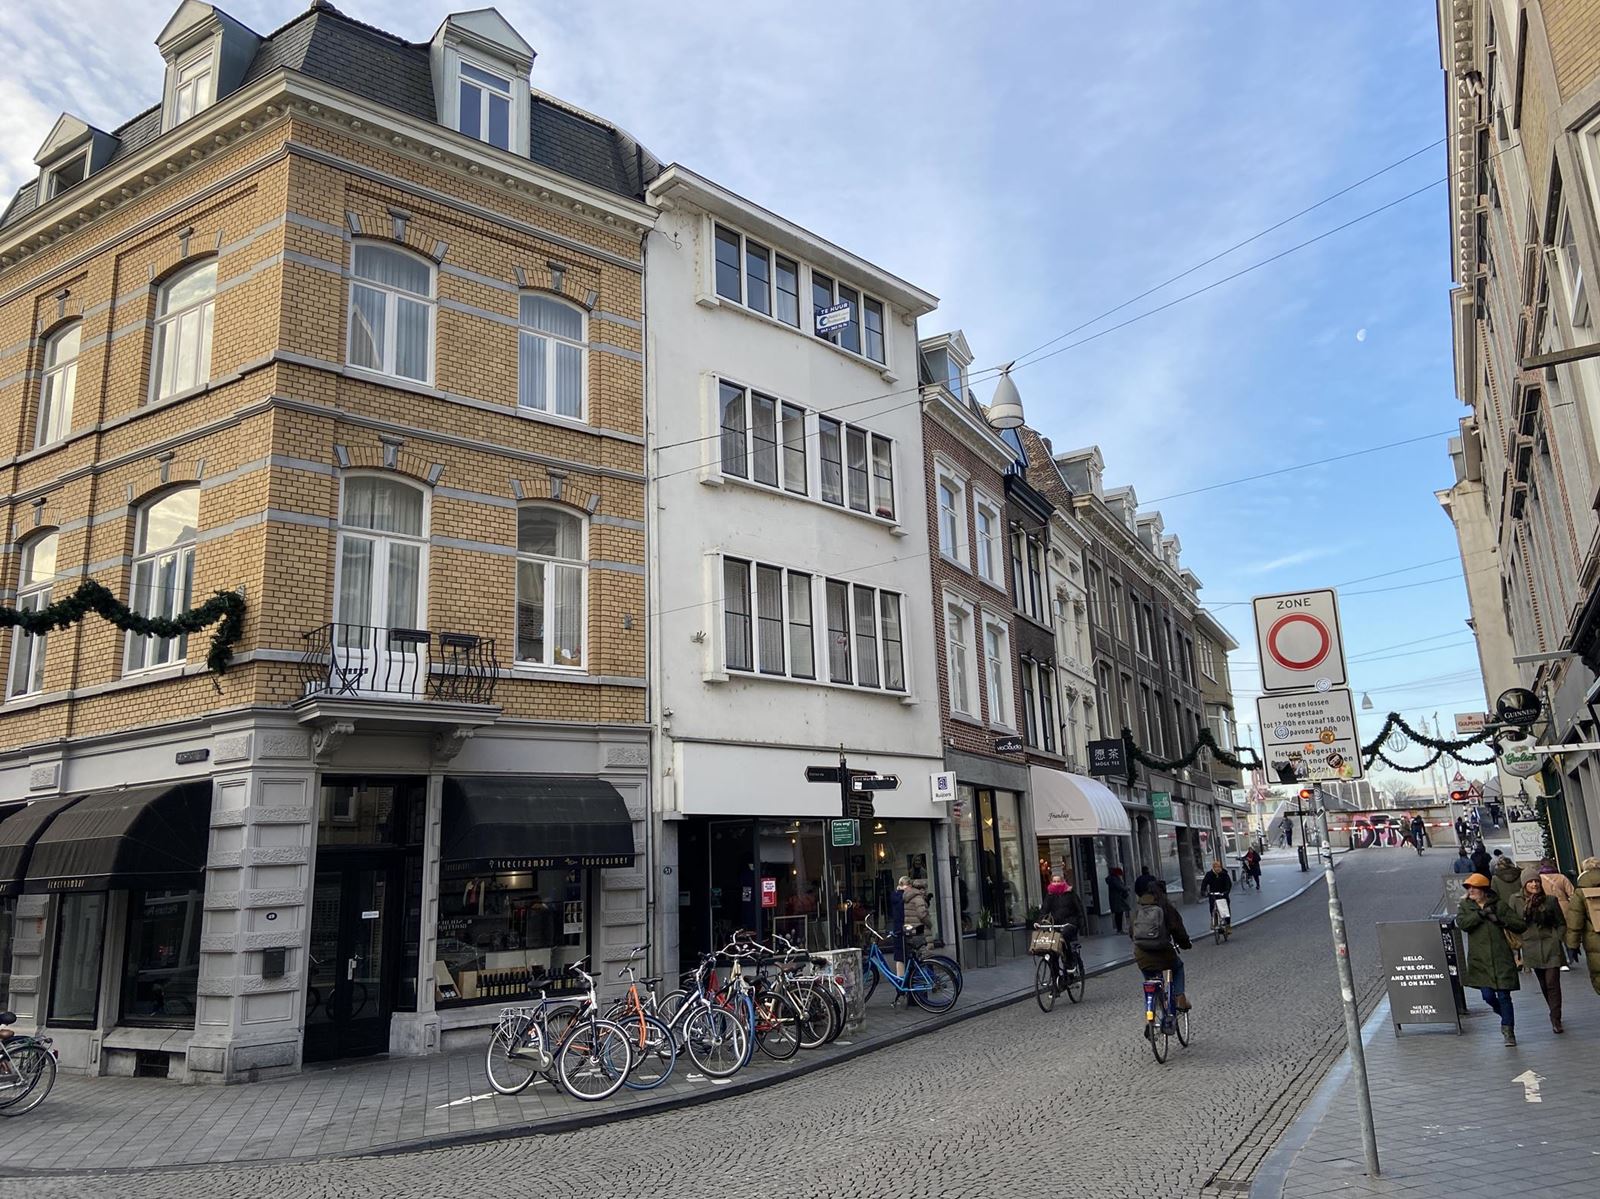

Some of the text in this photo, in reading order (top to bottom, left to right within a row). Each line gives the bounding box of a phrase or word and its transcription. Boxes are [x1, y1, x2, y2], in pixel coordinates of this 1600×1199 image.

[830, 302, 848, 312] HUUR
[1276, 597, 1312, 610] ZONE
[1278, 702, 1297, 710] laden
[1307, 699, 1330, 707] lossen
[1286, 709, 1324, 718] toegestaan
[1504, 708, 1538, 719] GUINNESS
[1263, 721, 1274, 729] tot
[1307, 717, 1326, 725] vanaf
[1326, 715, 1351, 723] 18.00h
[1504, 752, 1537, 765] Grolsch
[497, 858, 555, 868] icecreambar
